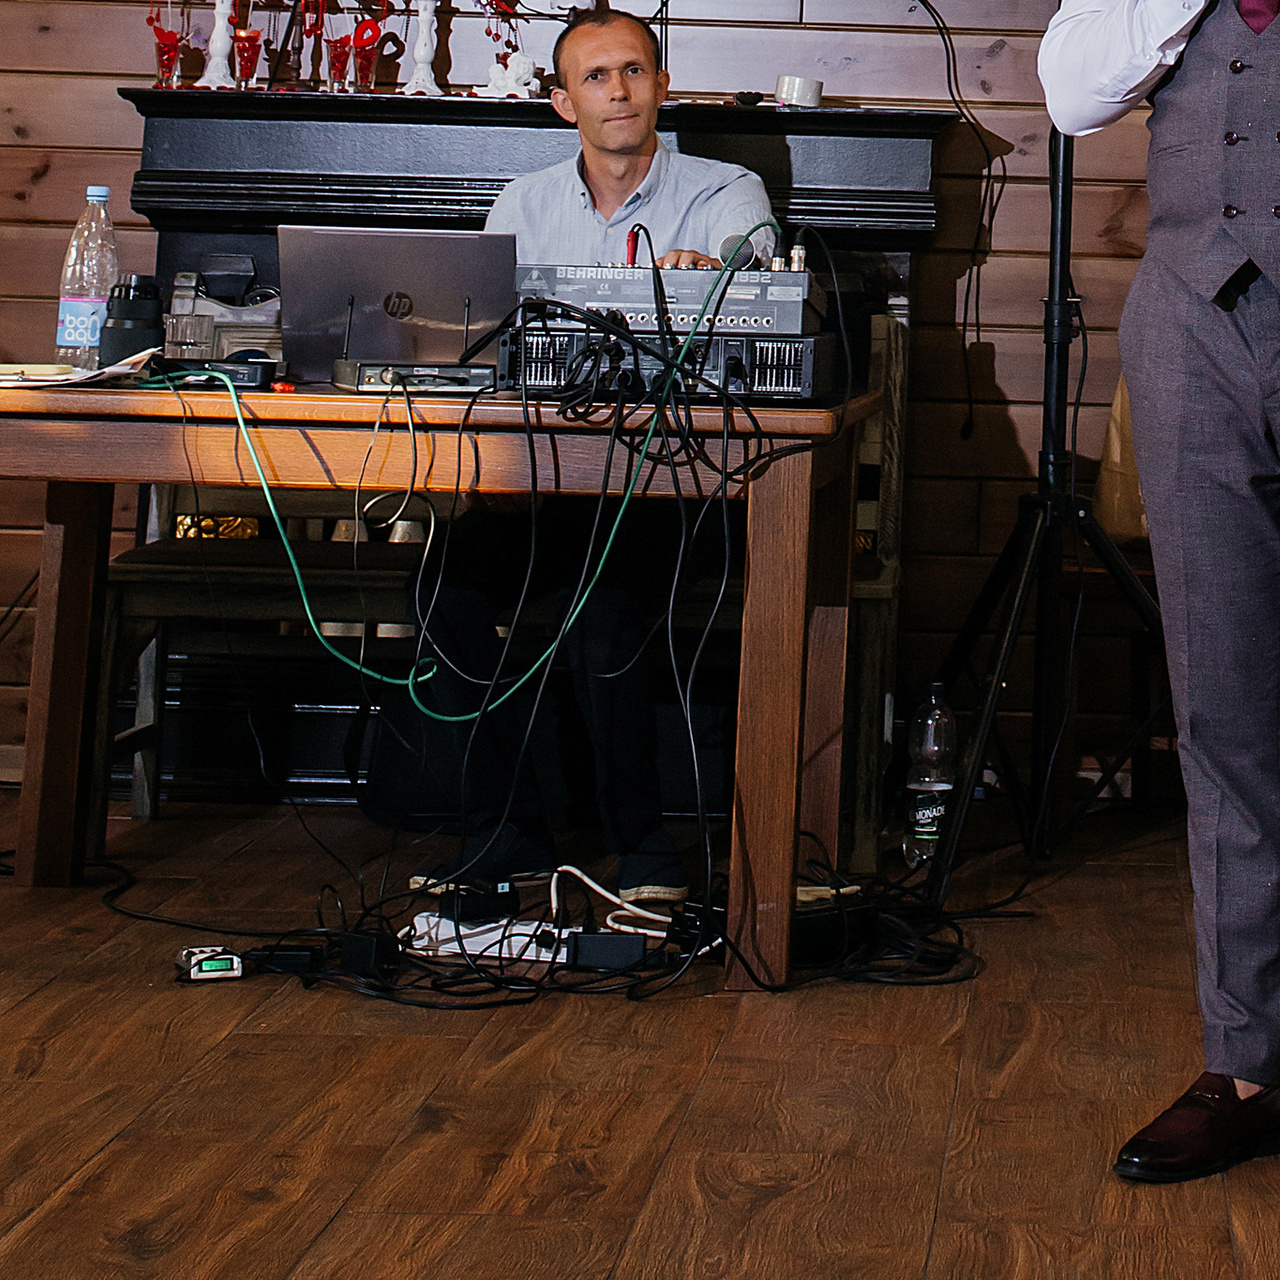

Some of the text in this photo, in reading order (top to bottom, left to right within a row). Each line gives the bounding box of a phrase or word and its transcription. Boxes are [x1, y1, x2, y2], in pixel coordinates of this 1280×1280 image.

[556, 267, 644, 280] BEHRINGER
[387, 290, 411, 319] hp
[66, 313, 100, 328] bon
[64, 328, 100, 344] aqu
